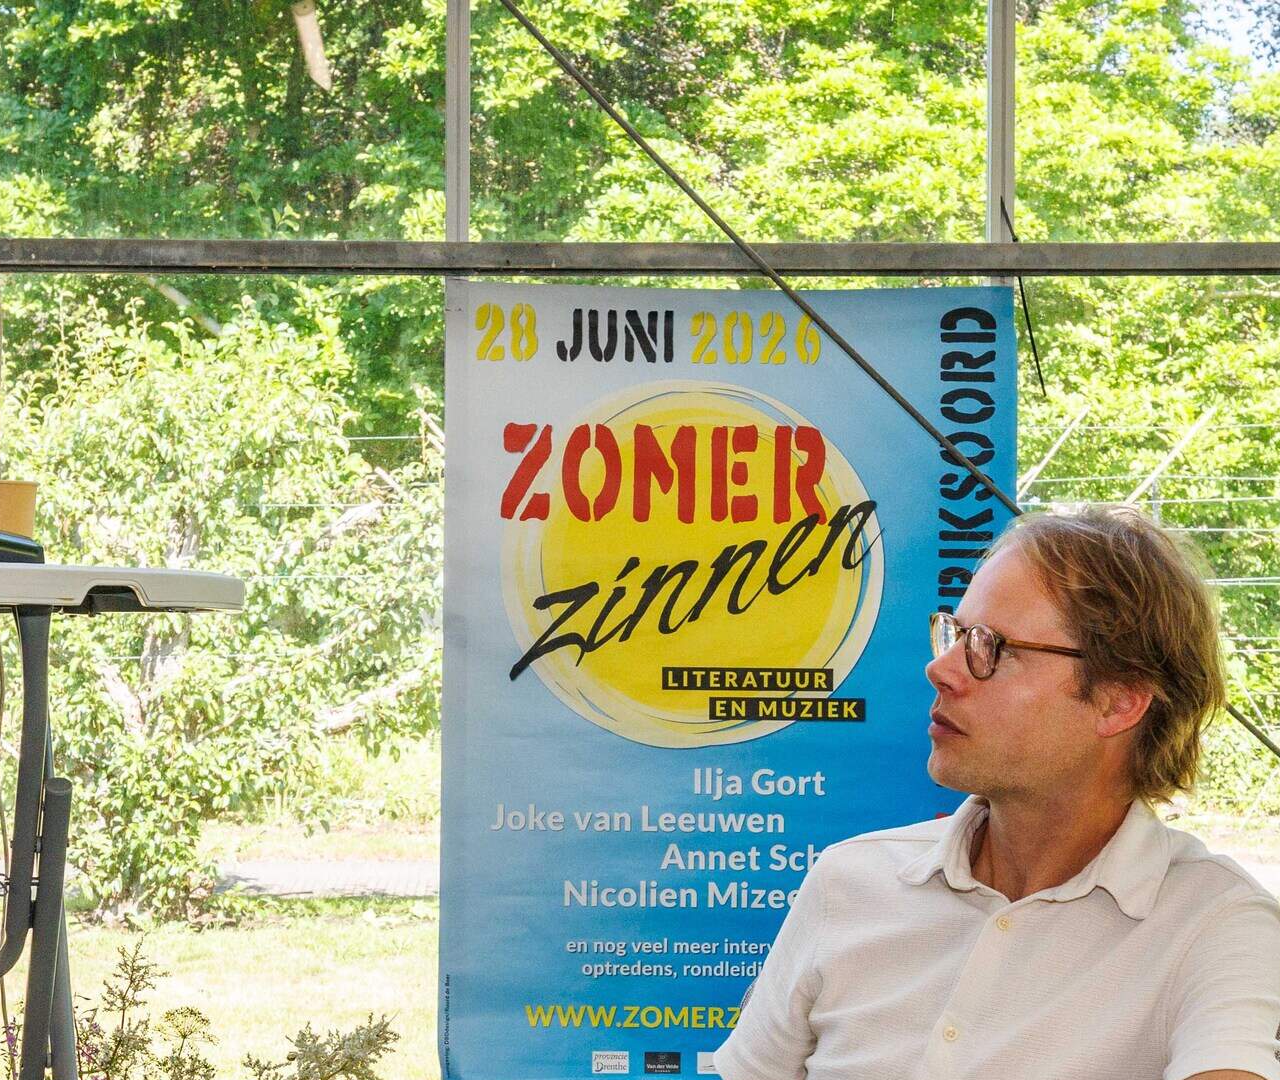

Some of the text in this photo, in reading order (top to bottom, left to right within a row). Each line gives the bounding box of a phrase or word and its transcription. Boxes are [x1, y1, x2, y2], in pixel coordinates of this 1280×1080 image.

[475, 302, 821, 366] 28 JUNI 2026
[500, 421, 830, 525] ZOMER
[938, 306, 998, 614] RIKSOORD
[509, 500, 885, 681] zinnen
[667, 670, 828, 690] LITERATUUR
[715, 700, 858, 719] EN MUZIEK
[694, 768, 826, 801] Ilja Gort
[491, 803, 785, 834] Joke van Leeuwen
[660, 843, 761, 871] Annet
[564, 880, 697, 908] Nicolien
[566, 940, 588, 953] en
[593, 939, 627, 956] nog
[632, 938, 668, 953] veel
[673, 941, 719, 954] meer
[582, 961, 677, 978] optredens,
